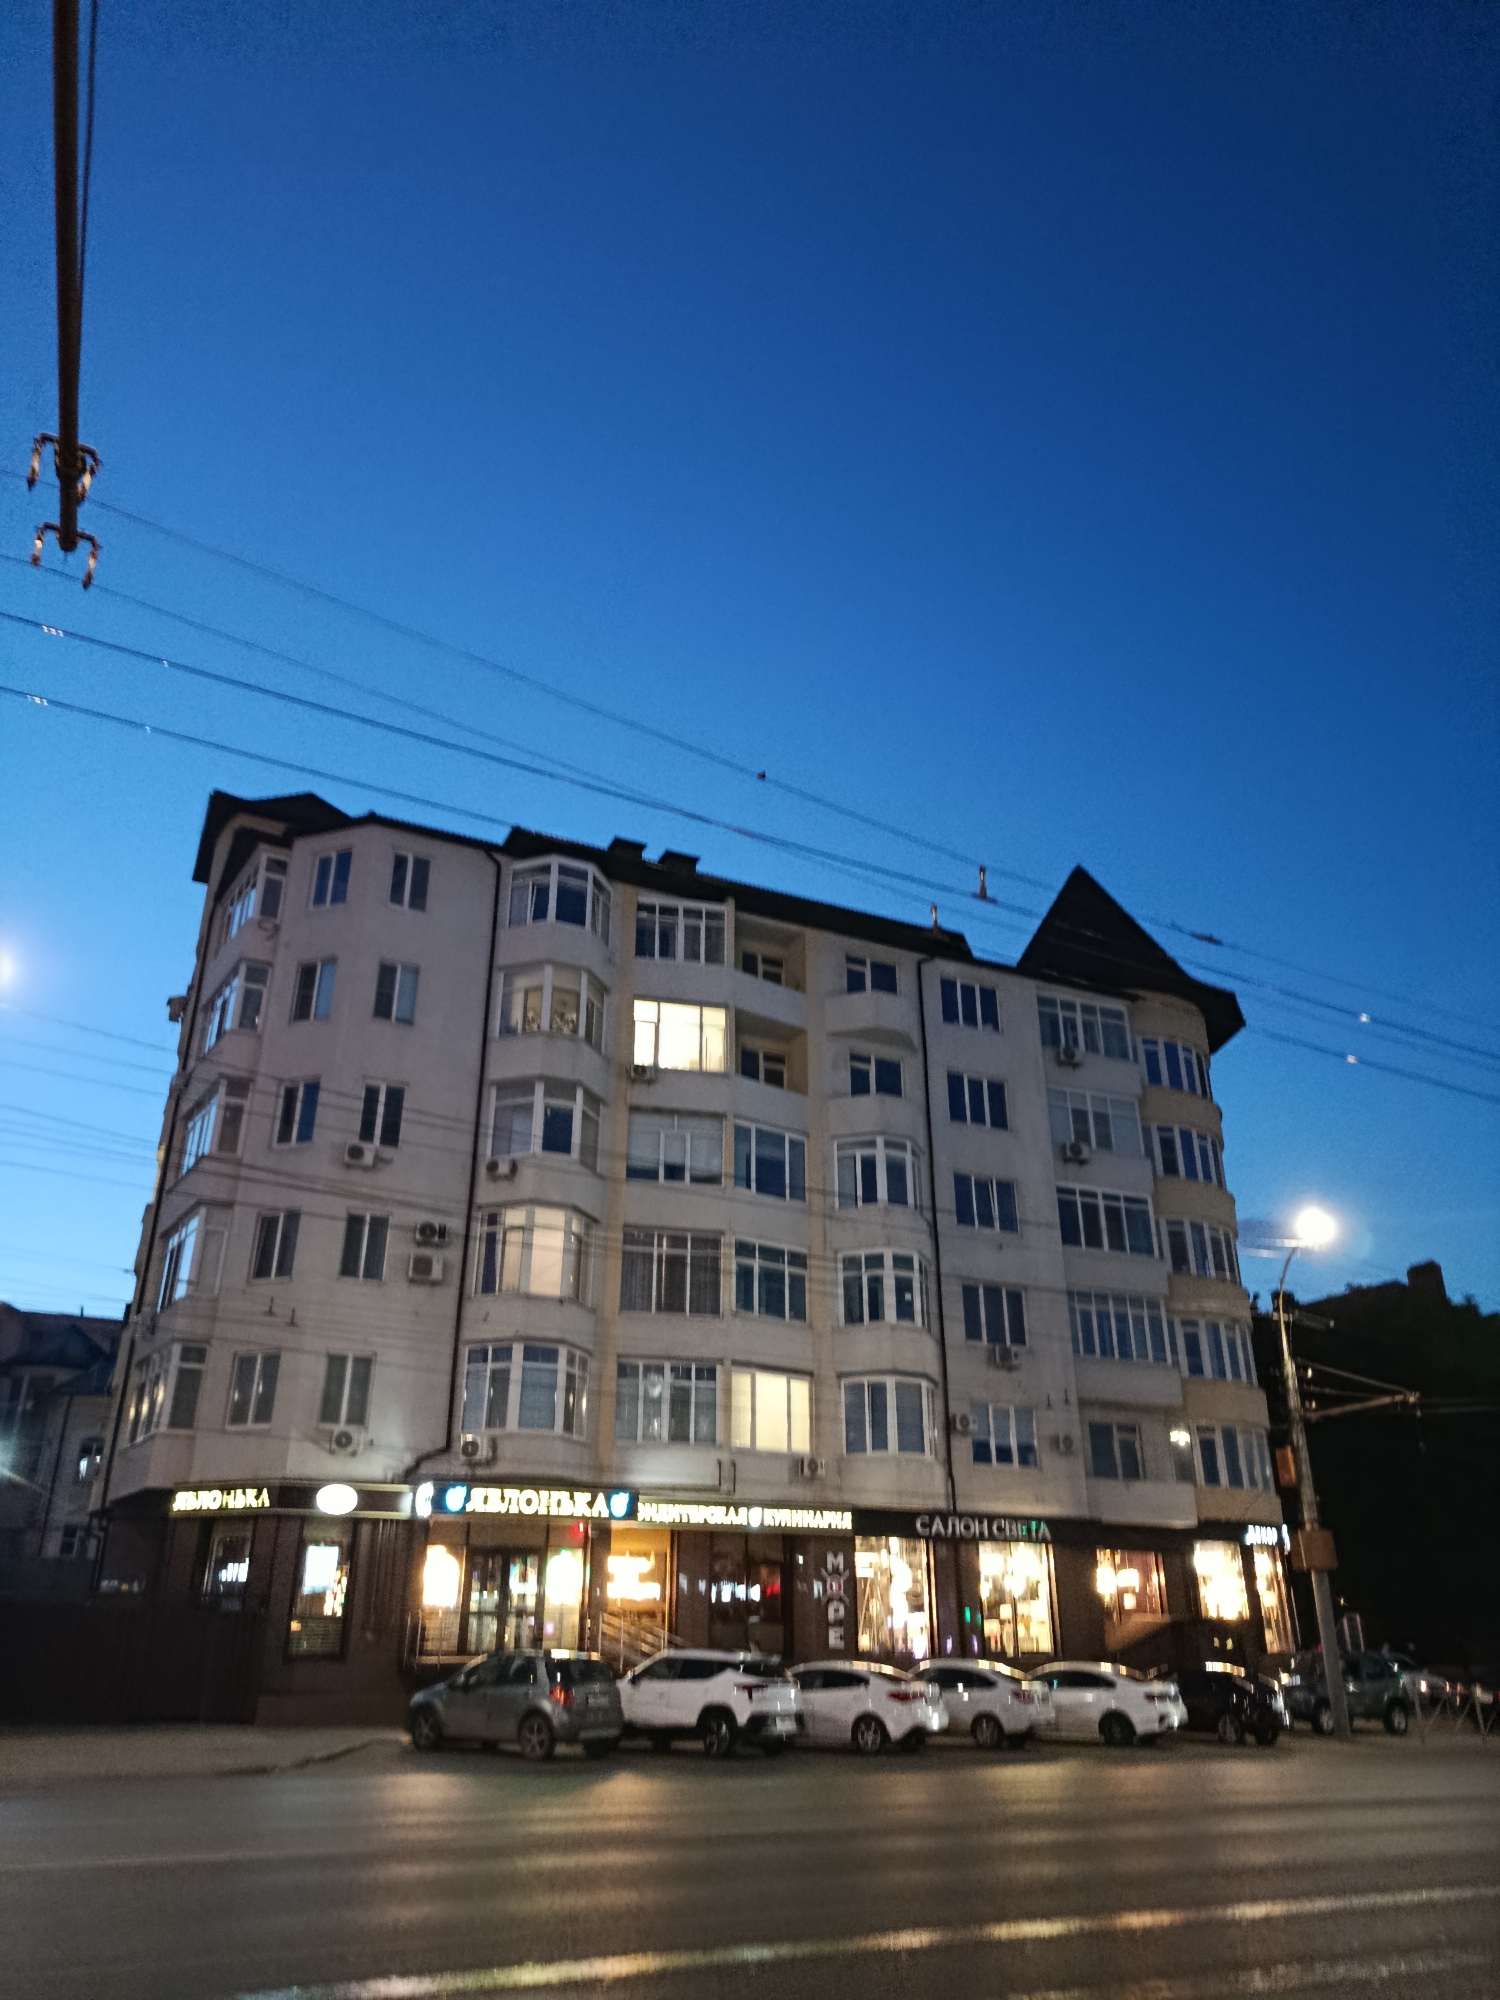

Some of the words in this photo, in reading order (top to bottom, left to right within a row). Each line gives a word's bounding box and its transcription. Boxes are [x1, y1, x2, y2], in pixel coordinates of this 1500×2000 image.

[172, 1487, 270, 1511] ЯБЛОНЬКА
[466, 1487, 609, 1518] ЯБЛОНЬКА
[763, 1507, 853, 1530] КУЛИНАРИЯ
[915, 1513, 989, 1539] САЛОН
[992, 1517, 1052, 1541] СВЕТА
